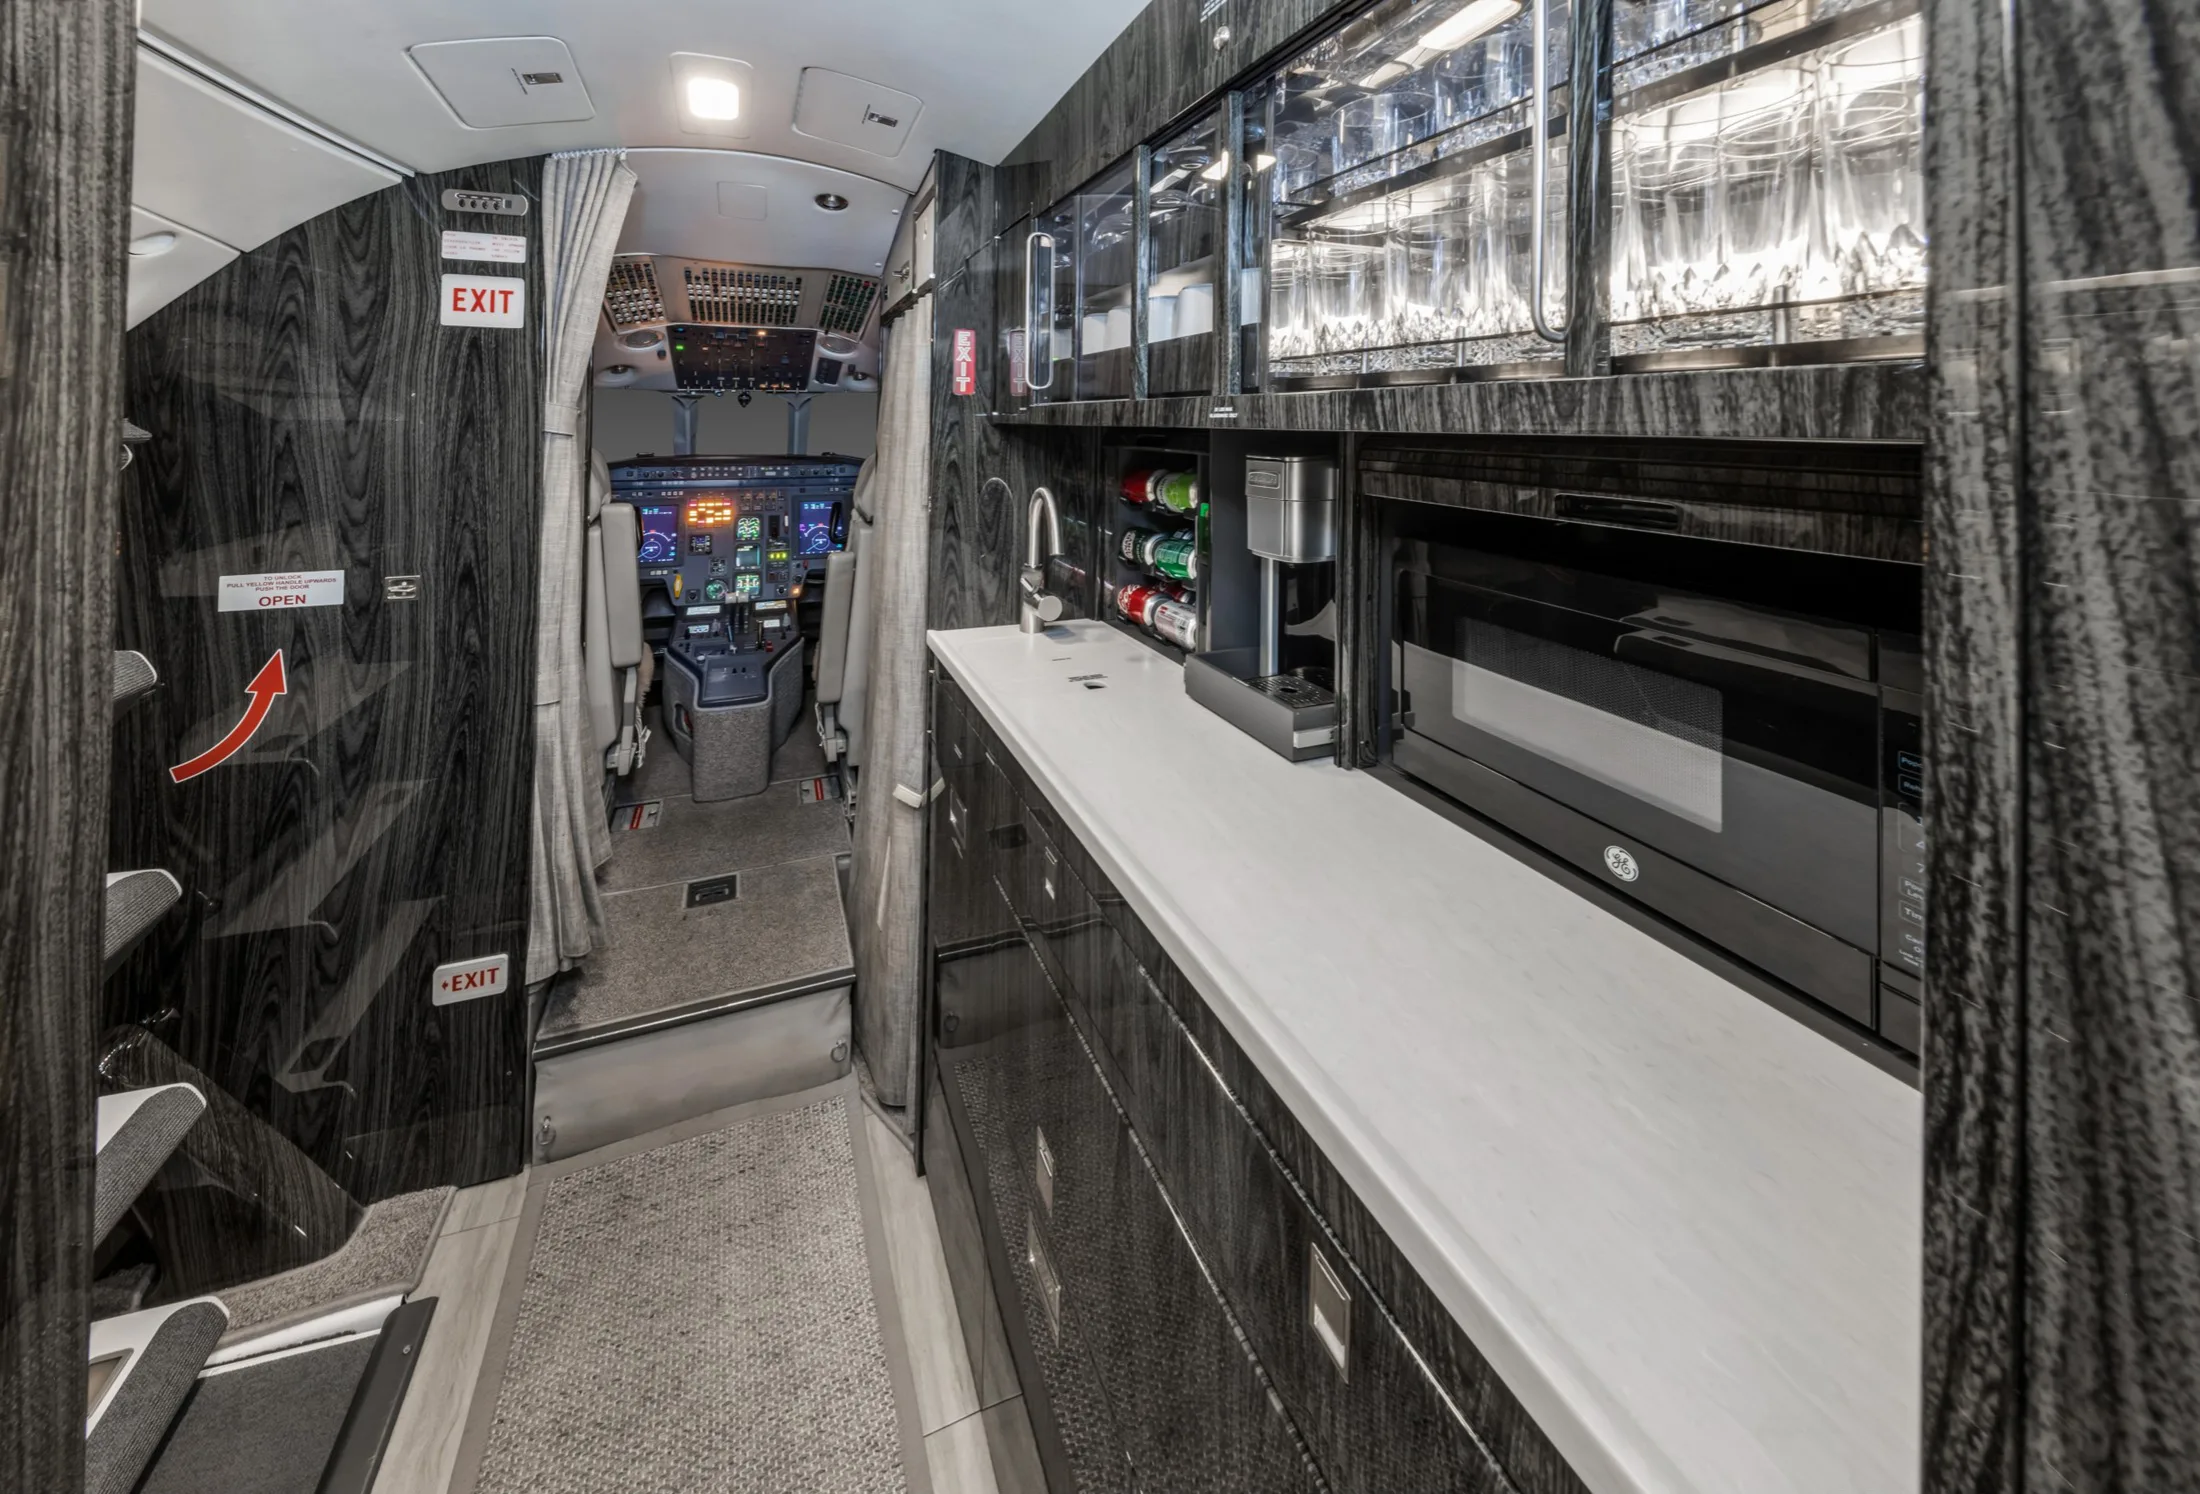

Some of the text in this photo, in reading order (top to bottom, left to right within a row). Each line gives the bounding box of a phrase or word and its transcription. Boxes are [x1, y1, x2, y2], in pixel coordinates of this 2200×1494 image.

[452, 287, 514, 314] EXIT
[956, 331, 972, 392] EXIT
[259, 594, 306, 607] OPEN
[452, 967, 500, 992] EXIT
